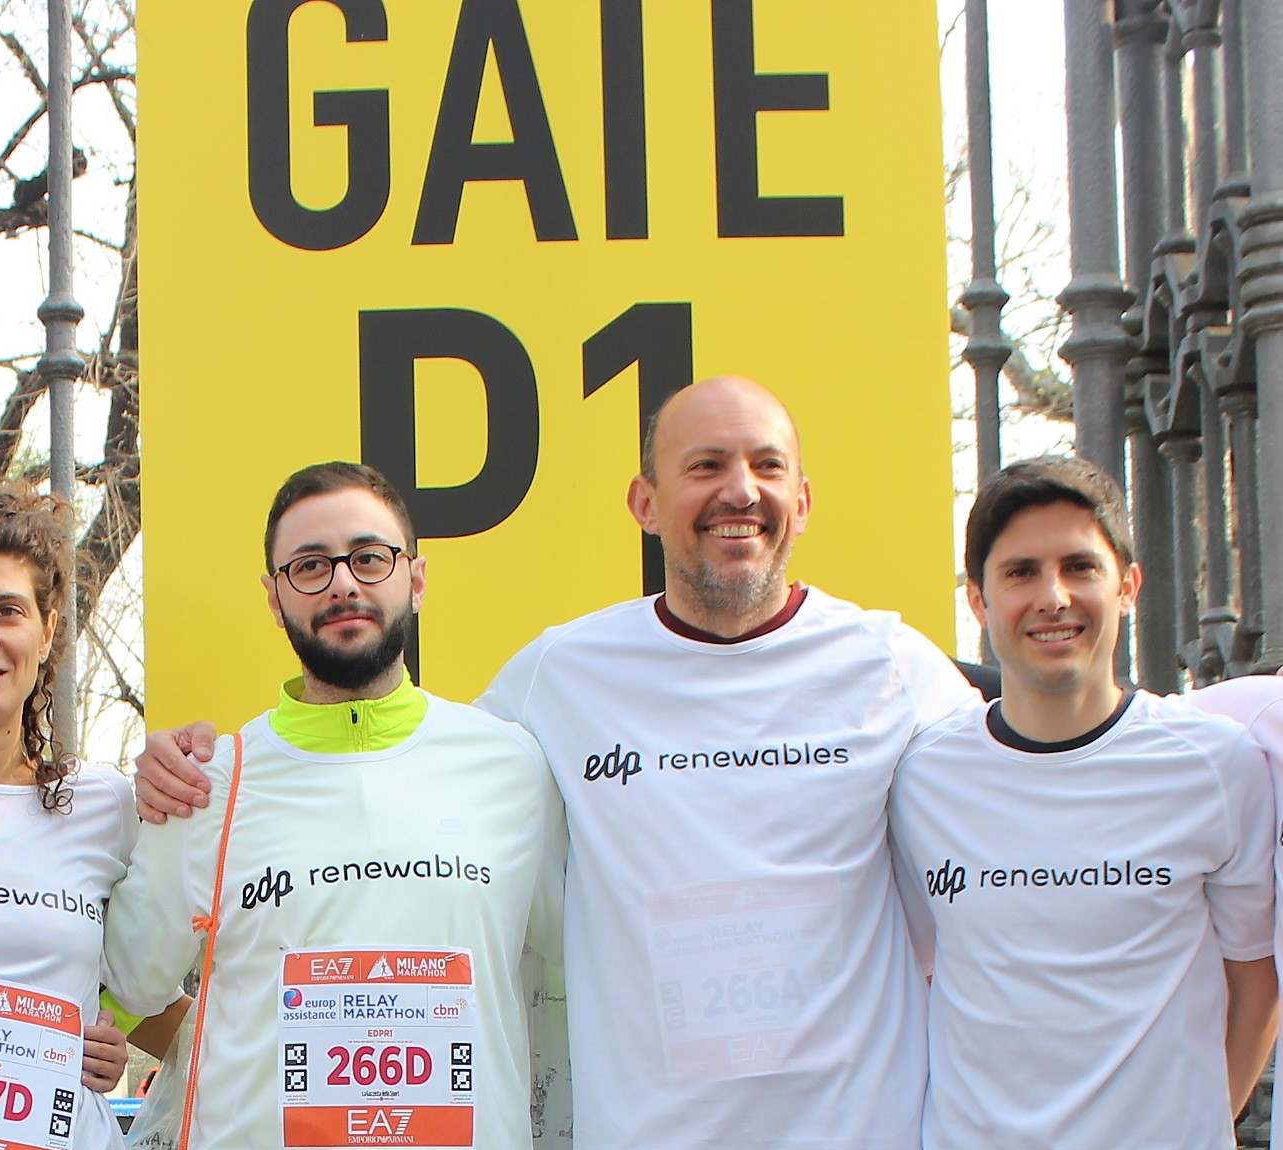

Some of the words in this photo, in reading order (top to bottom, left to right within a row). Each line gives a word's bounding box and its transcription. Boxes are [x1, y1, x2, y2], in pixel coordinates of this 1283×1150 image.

[584, 743, 641, 785] edp
[659, 742, 849, 770] renewables
[241, 866, 293, 909] edp
[310, 855, 490, 885] renewables
[980, 860, 1171, 887] renewables
[311, 958, 354, 976] EA7
[397, 958, 446, 969] MILANO
[397, 969, 446, 977] MARATHON
[305, 1000, 336, 1010] europ
[344, 995, 398, 1007] RELAY
[702, 969, 806, 1018] 266A
[16, 995, 62, 1016] MILANO
[16, 1006, 62, 1023] MARATHON
[283, 1010, 336, 1020] assistance
[344, 1008, 425, 1019] MARATHON
[433, 1004, 459, 1015] cbm
[44, 1048, 67, 1062] cbm
[327, 1046, 432, 1085] 266D
[347, 1109, 413, 1135] EA7
